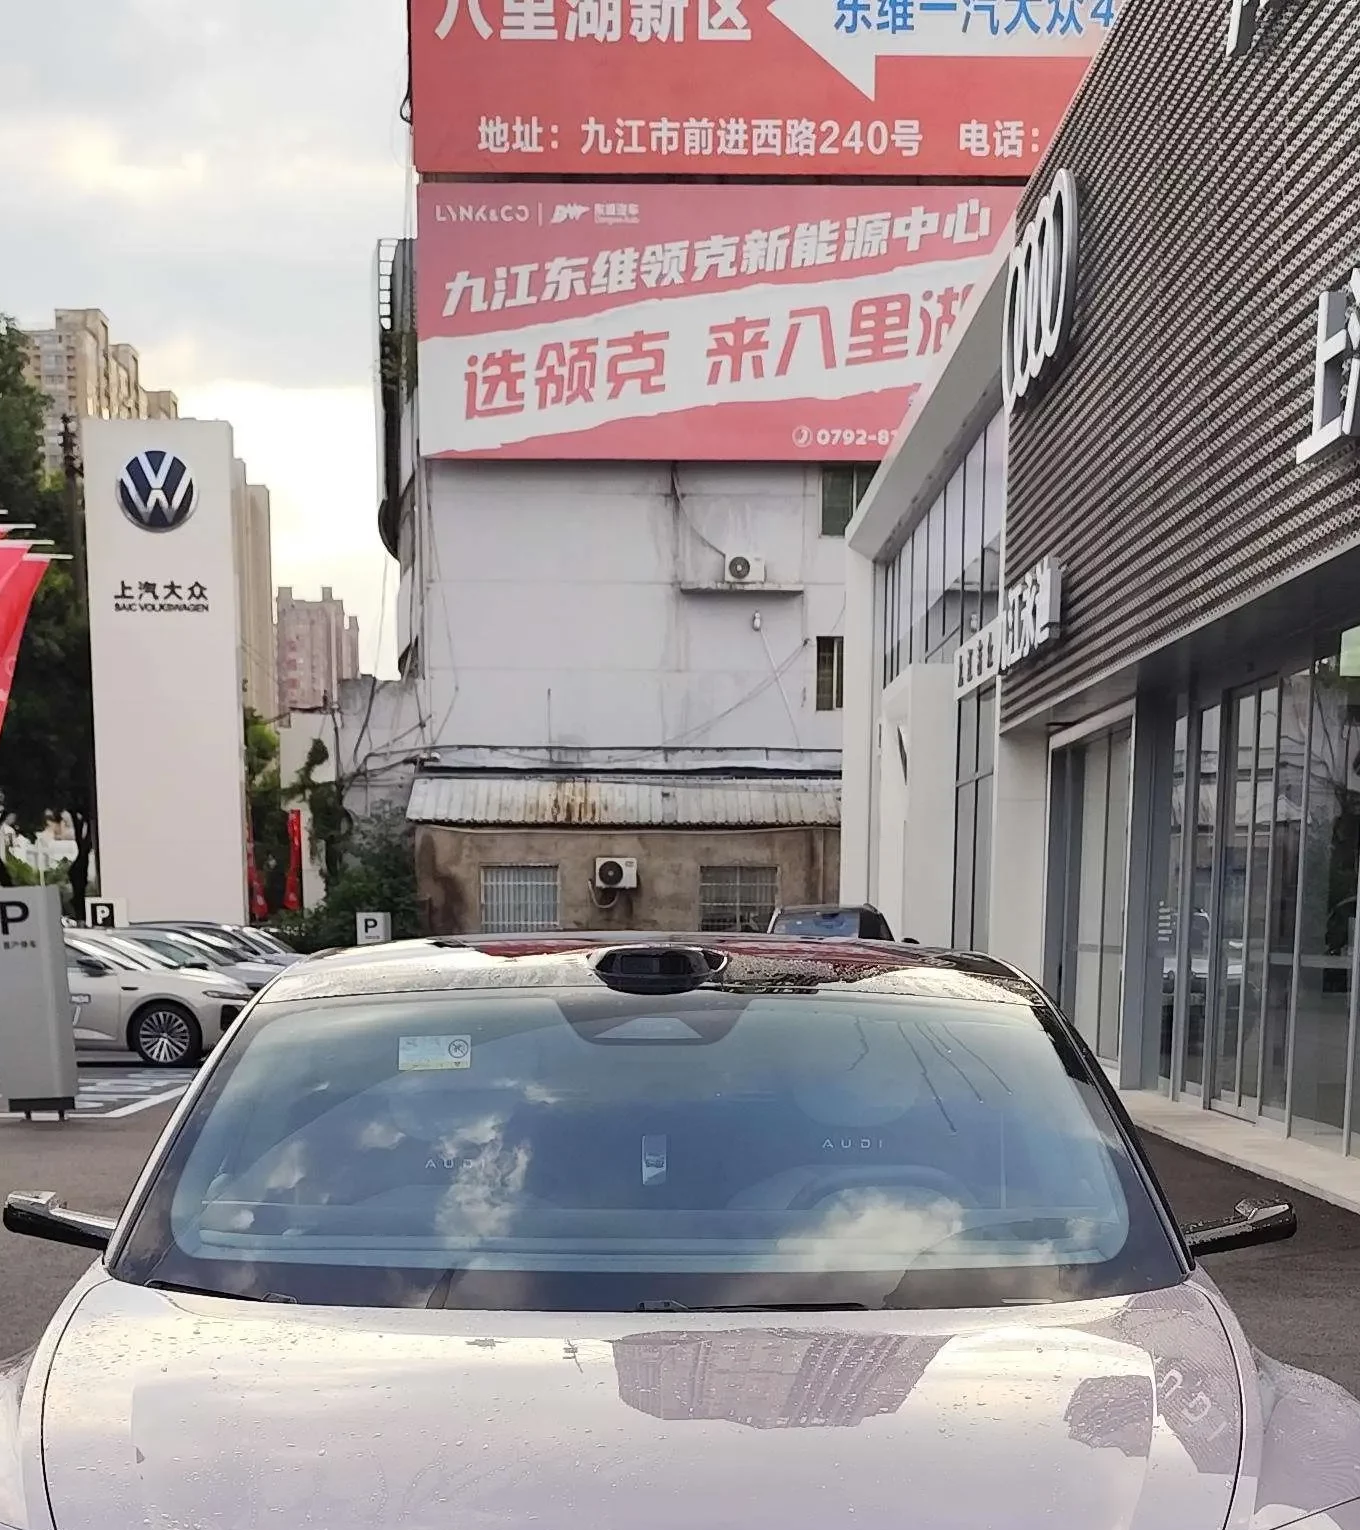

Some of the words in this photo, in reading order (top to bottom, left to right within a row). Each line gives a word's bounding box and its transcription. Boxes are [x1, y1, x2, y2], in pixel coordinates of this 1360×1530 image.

[441, 198, 992, 319] 九江东维领克新能源中心
[463, 330, 671, 421] 选领克
[114, 580, 209, 600] 上汽大众
[0, 901, 30, 935] P
[96, 905, 110, 925] P
[364, 918, 378, 933] P
[822, 1138, 883, 1149] AUDI
[425, 1158, 486, 1169] AUDI
